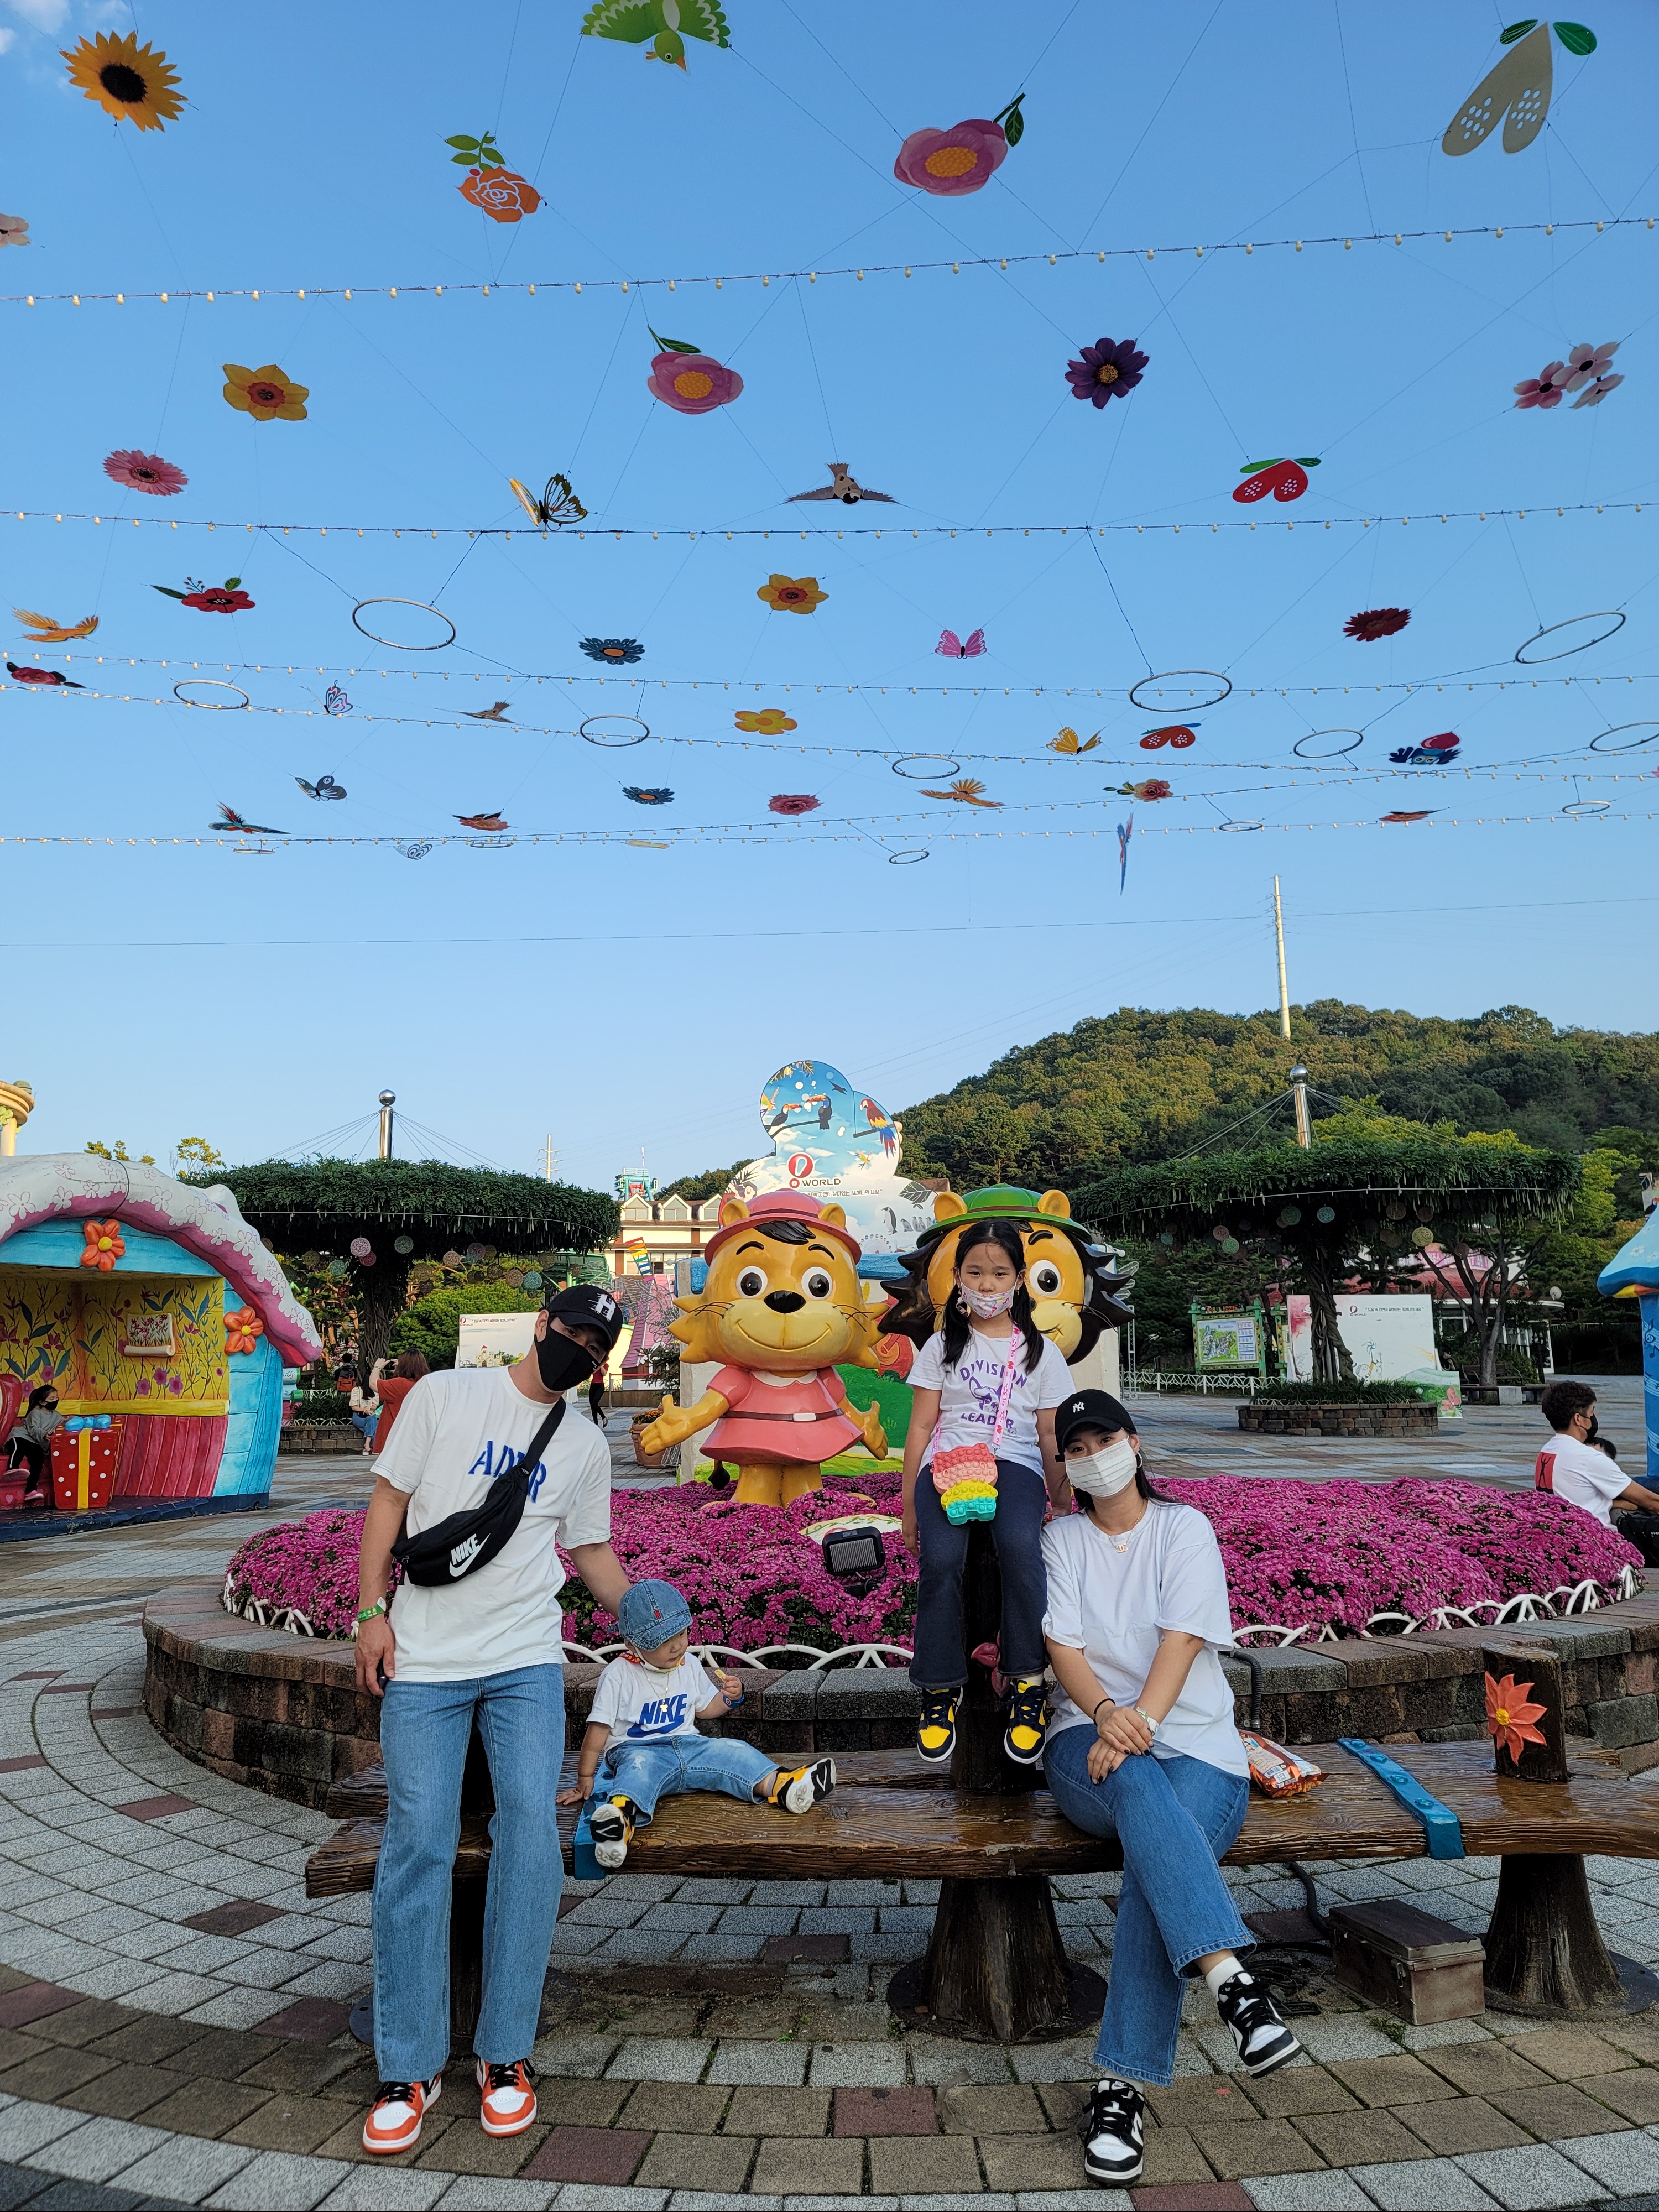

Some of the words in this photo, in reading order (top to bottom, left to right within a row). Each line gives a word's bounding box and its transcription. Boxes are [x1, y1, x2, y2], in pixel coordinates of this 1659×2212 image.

[802, 1178, 841, 1187] WORLD
[961, 1412, 1014, 1429] LEADR
[467, 1440, 547, 1503] ADR
[451, 1533, 479, 1566] NIKE
[639, 1693, 687, 1725] NIKE
